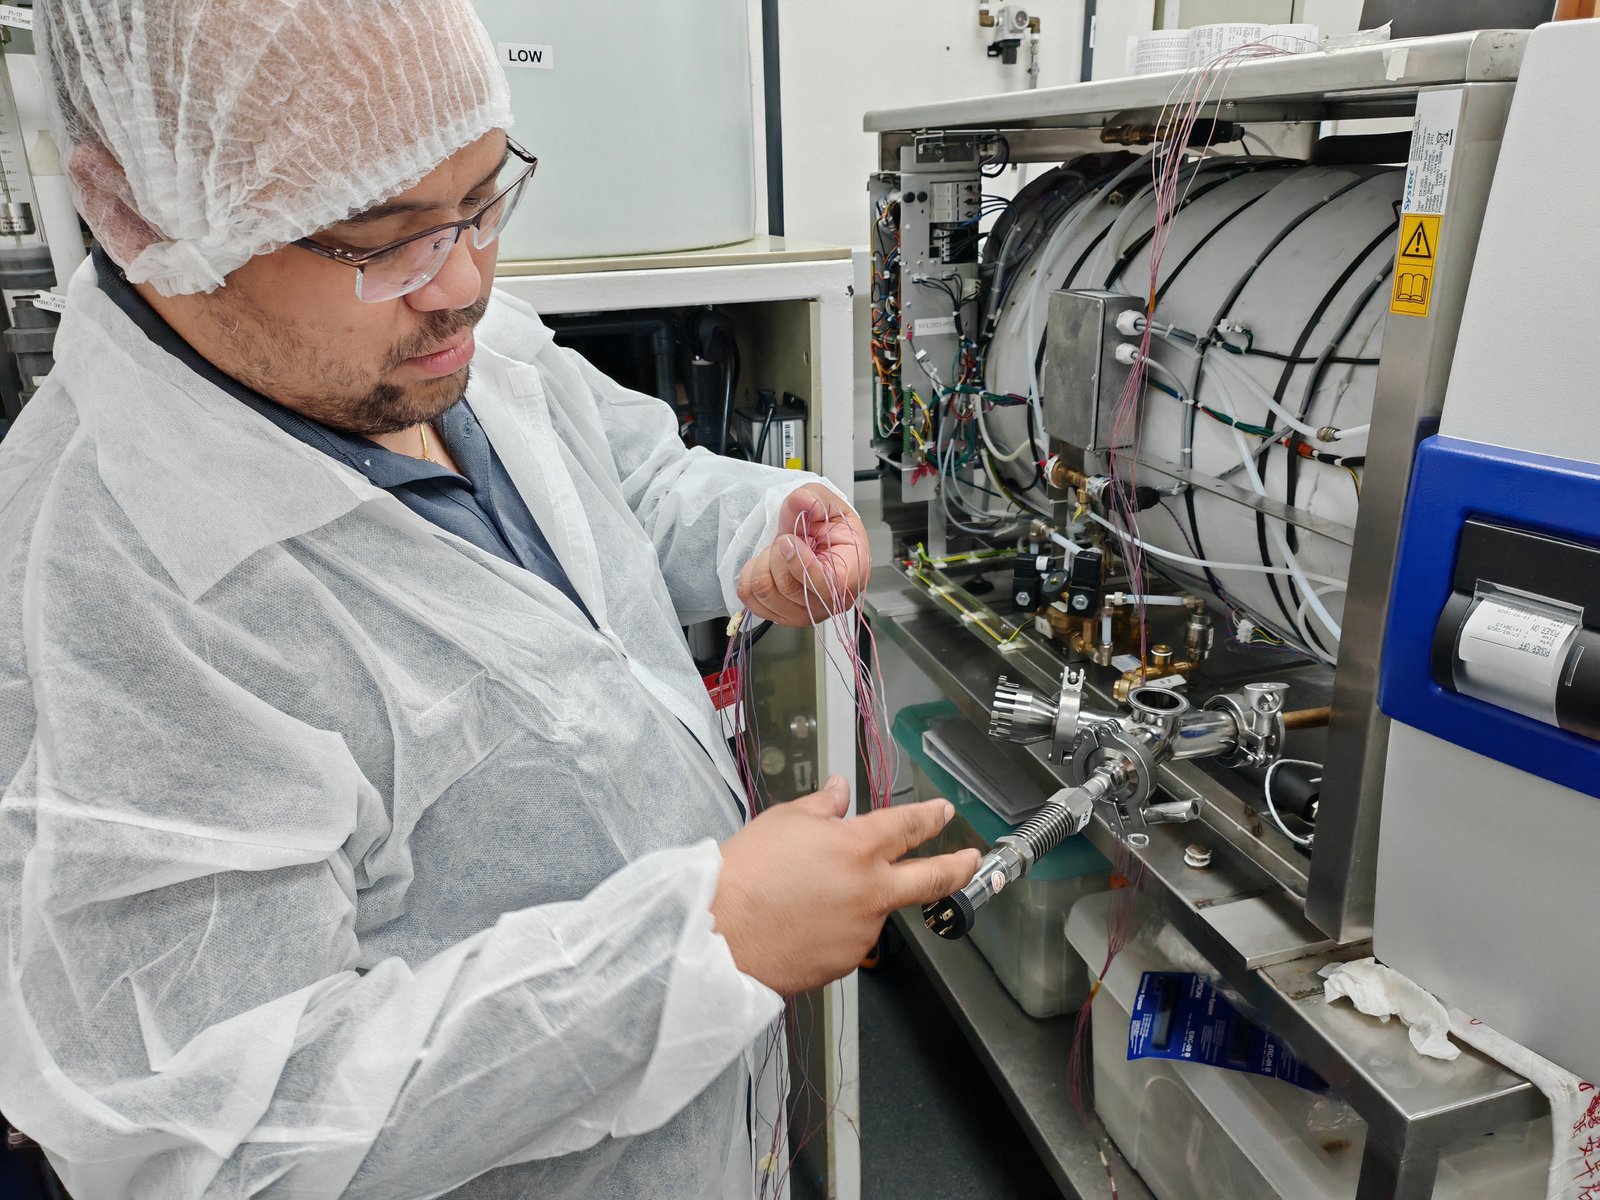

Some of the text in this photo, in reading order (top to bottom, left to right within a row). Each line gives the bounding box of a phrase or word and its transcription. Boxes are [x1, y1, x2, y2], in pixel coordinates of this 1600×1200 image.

[509, 49, 542, 63] LOW
[1404, 170, 1415, 210] Systec
[1540, 626, 1560, 637] POWER
[1517, 642, 1550, 656] POWER OFF
